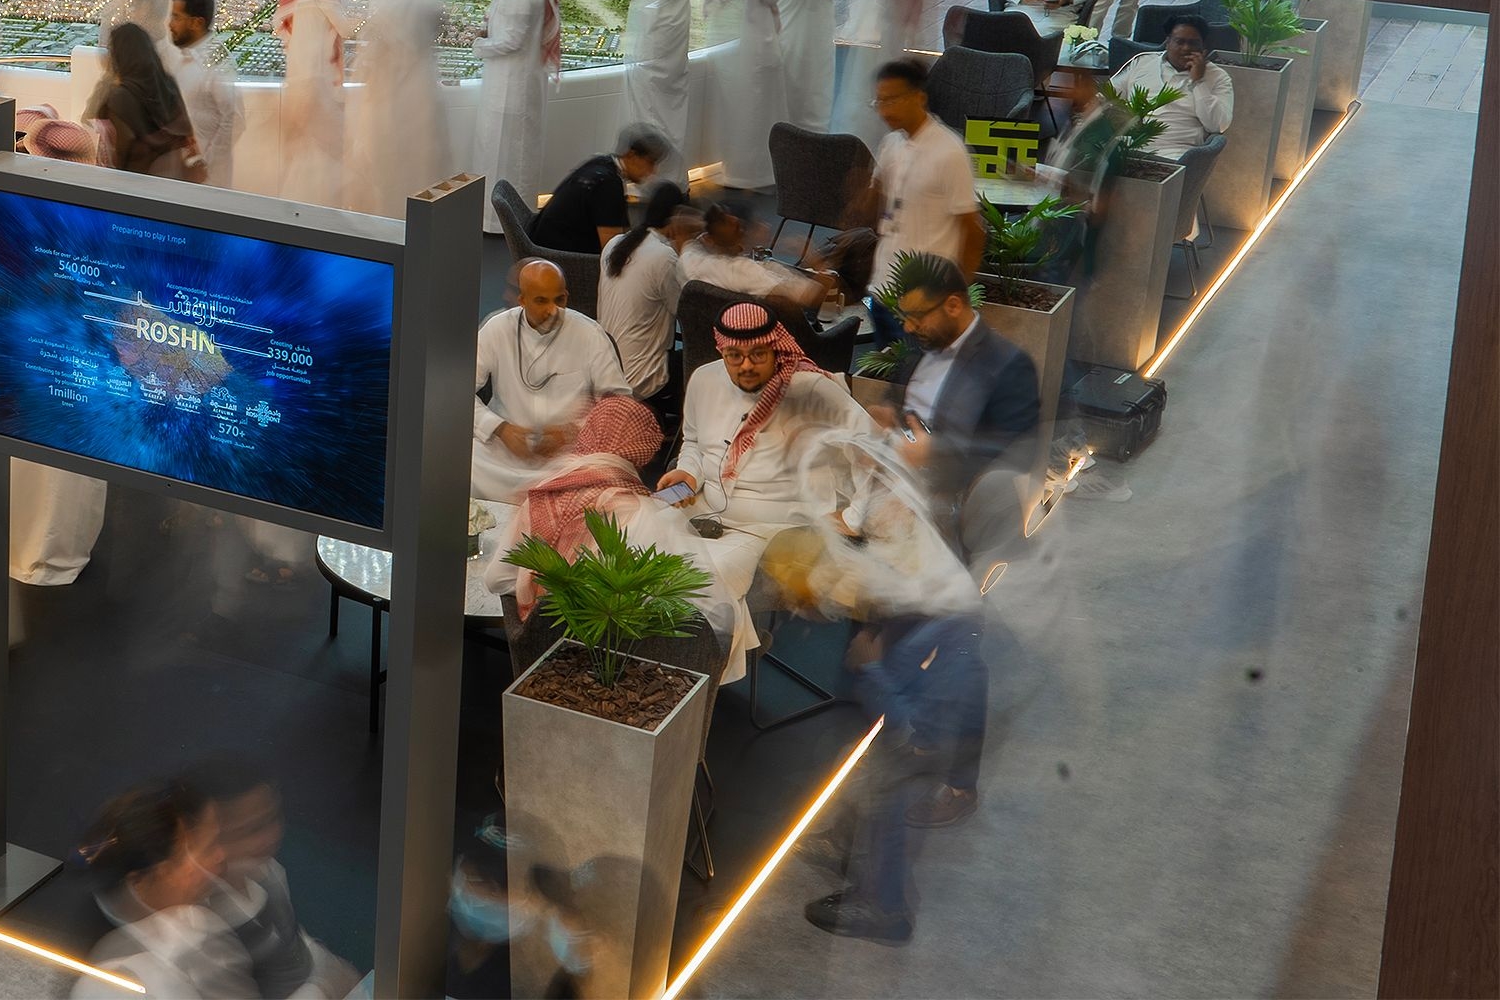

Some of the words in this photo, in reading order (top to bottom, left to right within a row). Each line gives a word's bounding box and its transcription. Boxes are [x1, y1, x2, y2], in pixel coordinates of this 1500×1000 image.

[111, 223, 144, 239] Preparing
[144, 230, 152, 239] to
[152, 232, 166, 243] play
[34, 246, 53, 256] Schools
[59, 260, 100, 278] 540,000
[166, 282, 208, 297] Accommodating
[136, 317, 215, 355] ROSHN
[269, 338, 293, 350] Creating
[267, 346, 313, 367] 339,000
[25, 362, 55, 376] Contributing
[275, 372, 311, 384] opportunities
[48, 384, 88, 404] 1million
[218, 422, 246, 438] 570+
